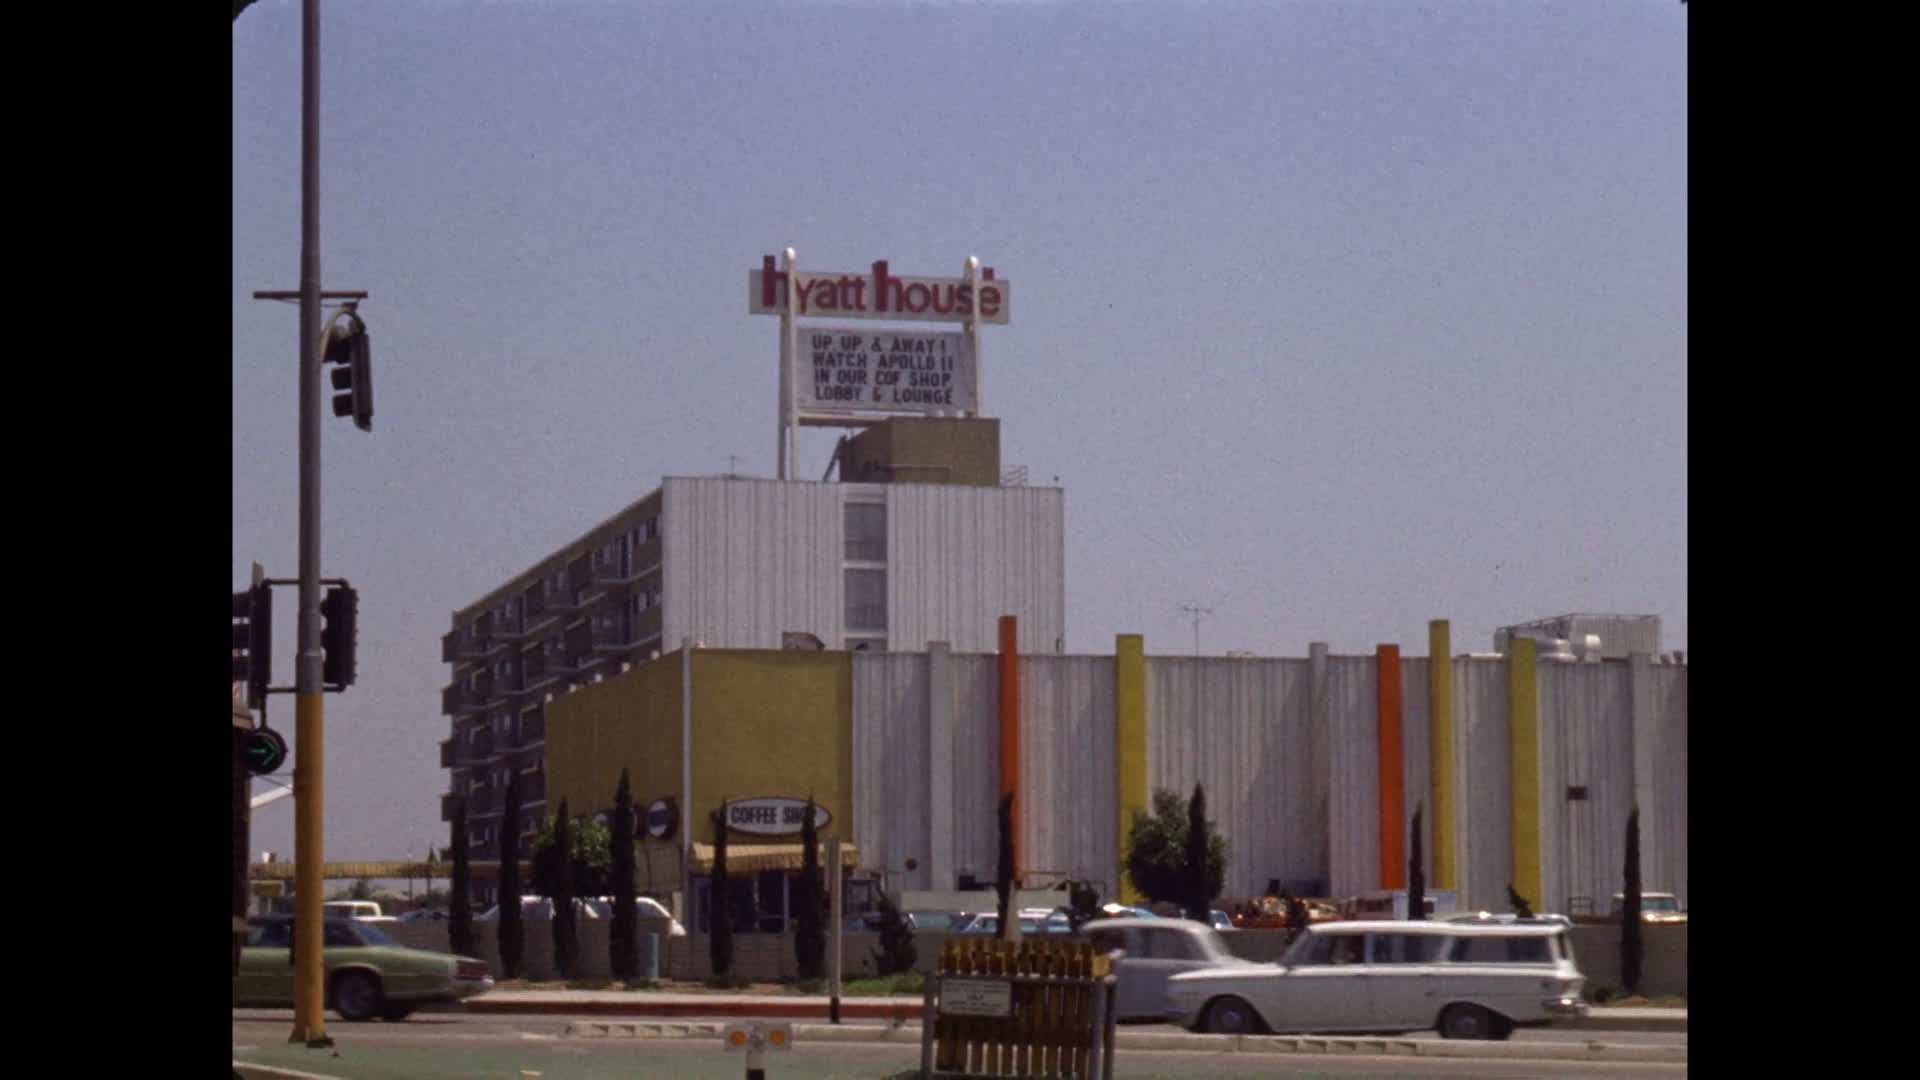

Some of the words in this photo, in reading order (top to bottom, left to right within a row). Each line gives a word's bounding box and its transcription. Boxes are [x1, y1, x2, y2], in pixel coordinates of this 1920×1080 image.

[763, 255, 866, 313] hyatt
[872, 260, 1001, 317] house
[871, 337, 882, 351] &
[813, 352, 867, 368] WATCH
[878, 354, 936, 370] APOLLO
[815, 369, 830, 384] IN
[837, 370, 867, 385] OUR
[910, 372, 952, 387] SHOP
[815, 386, 861, 401] LOBBY
[872, 388, 881, 402] &
[893, 389, 952, 405] LOUNGE
[731, 806, 777, 824] COFFEE
